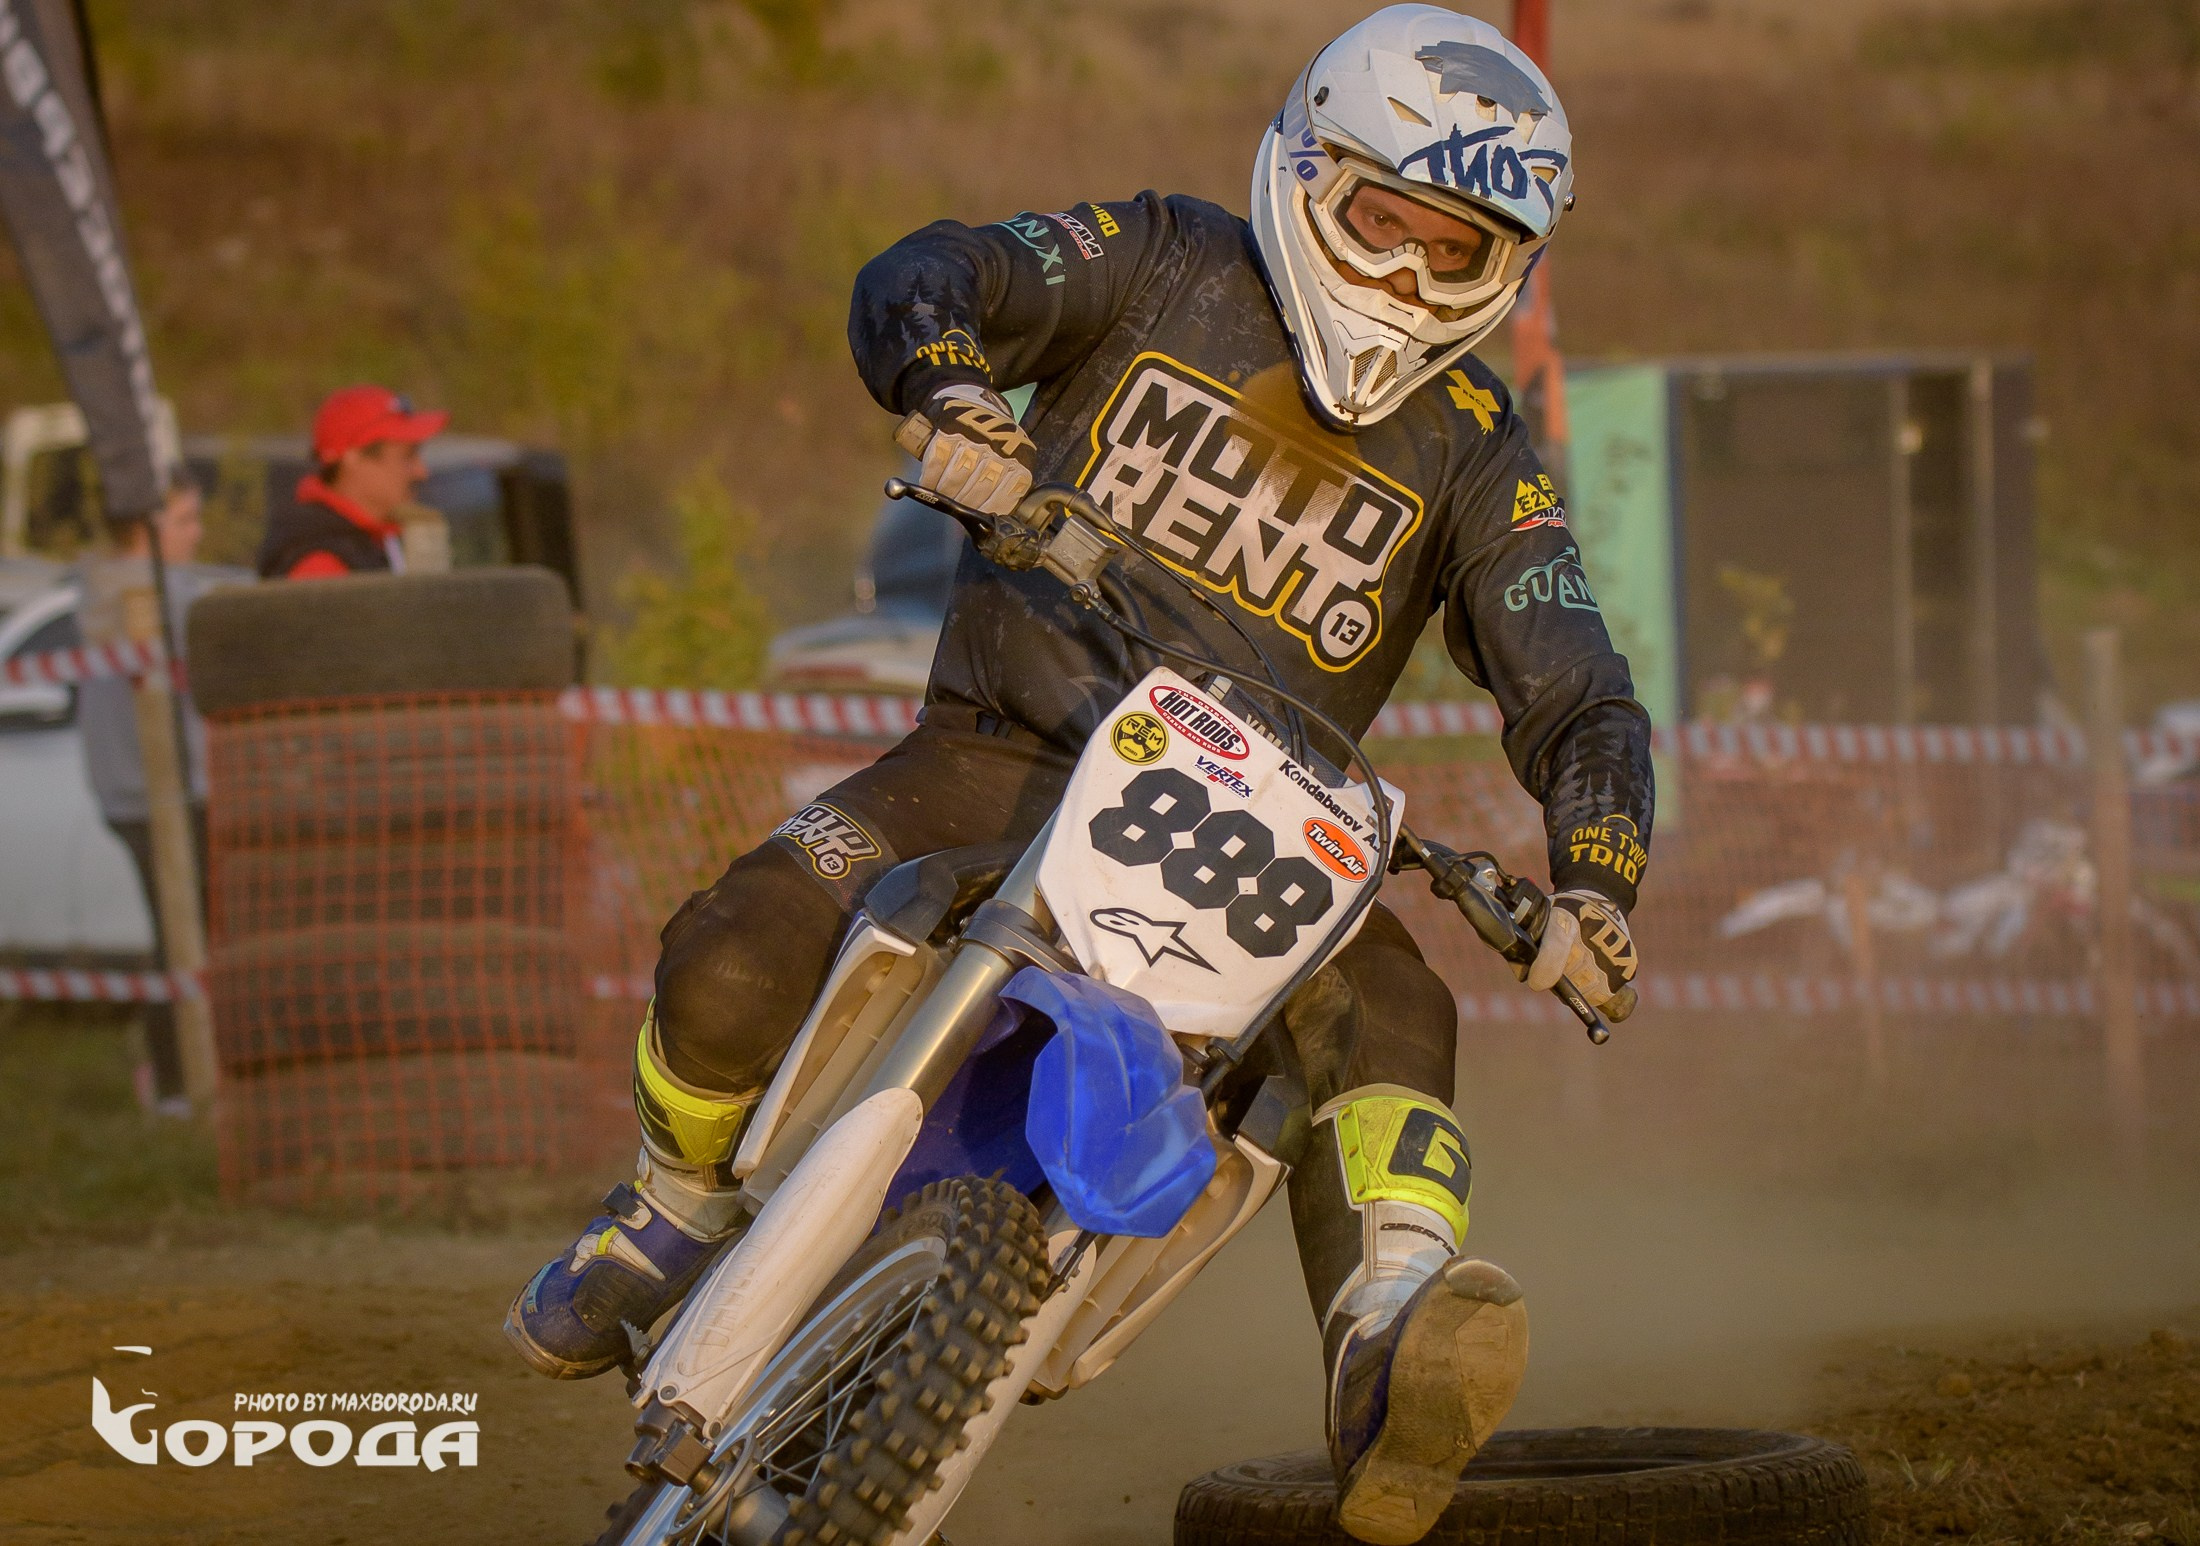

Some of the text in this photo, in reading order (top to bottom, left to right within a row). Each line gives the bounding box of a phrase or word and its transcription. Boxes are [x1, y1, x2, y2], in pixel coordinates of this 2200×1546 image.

[1117, 381, 1402, 566] MOTO
[1088, 445, 1357, 625] RENT
[1328, 611, 1365, 646] 13
[1126, 717, 1163, 746] REM
[1157, 690, 1241, 751] HOT RODS
[1196, 755, 1255, 798] VERTEX
[1278, 759, 1363, 833] Kondabarov
[794, 805, 872, 850] OTO
[1308, 823, 1366, 876] Twin Air
[1571, 825, 1612, 842] ONE
[823, 856, 841, 871] 13
[1088, 768, 1334, 958] 888
